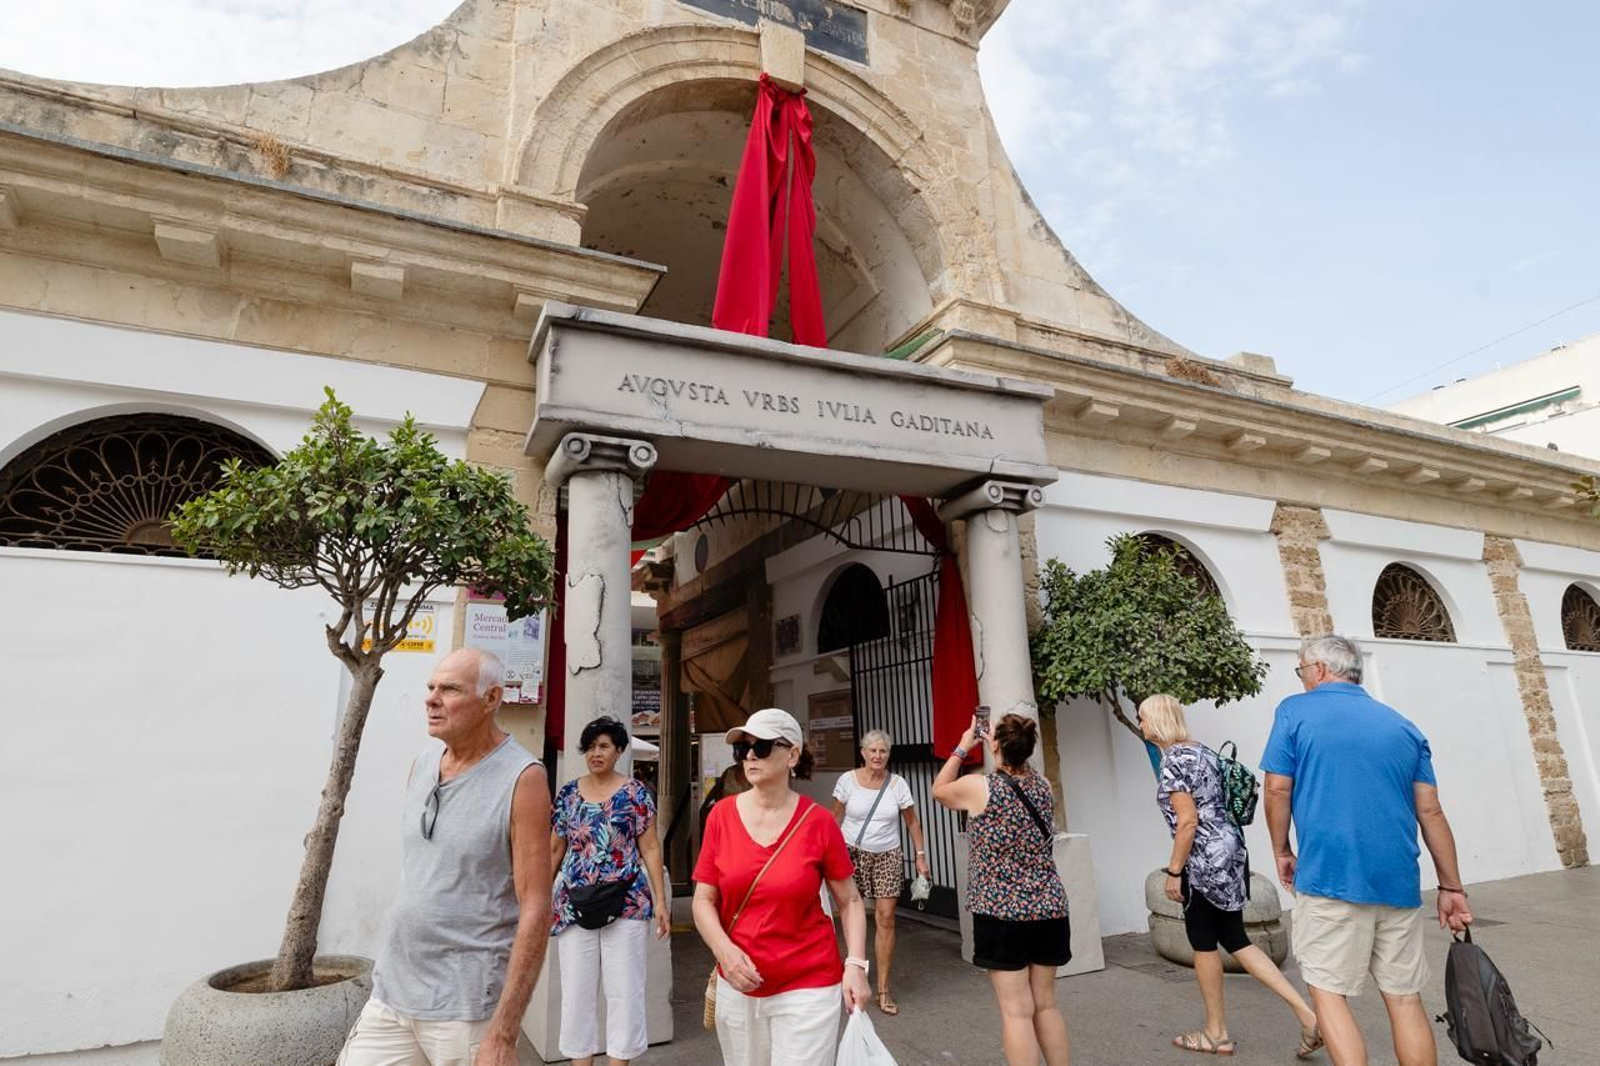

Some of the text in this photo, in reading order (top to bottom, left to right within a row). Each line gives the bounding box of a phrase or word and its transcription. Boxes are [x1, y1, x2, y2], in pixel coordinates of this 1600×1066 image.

[617, 374, 995, 440] AVGVSTA VRBS IVLIA GADITANA
[474, 612, 508, 623] Mercad
[473, 622, 507, 632] Central
